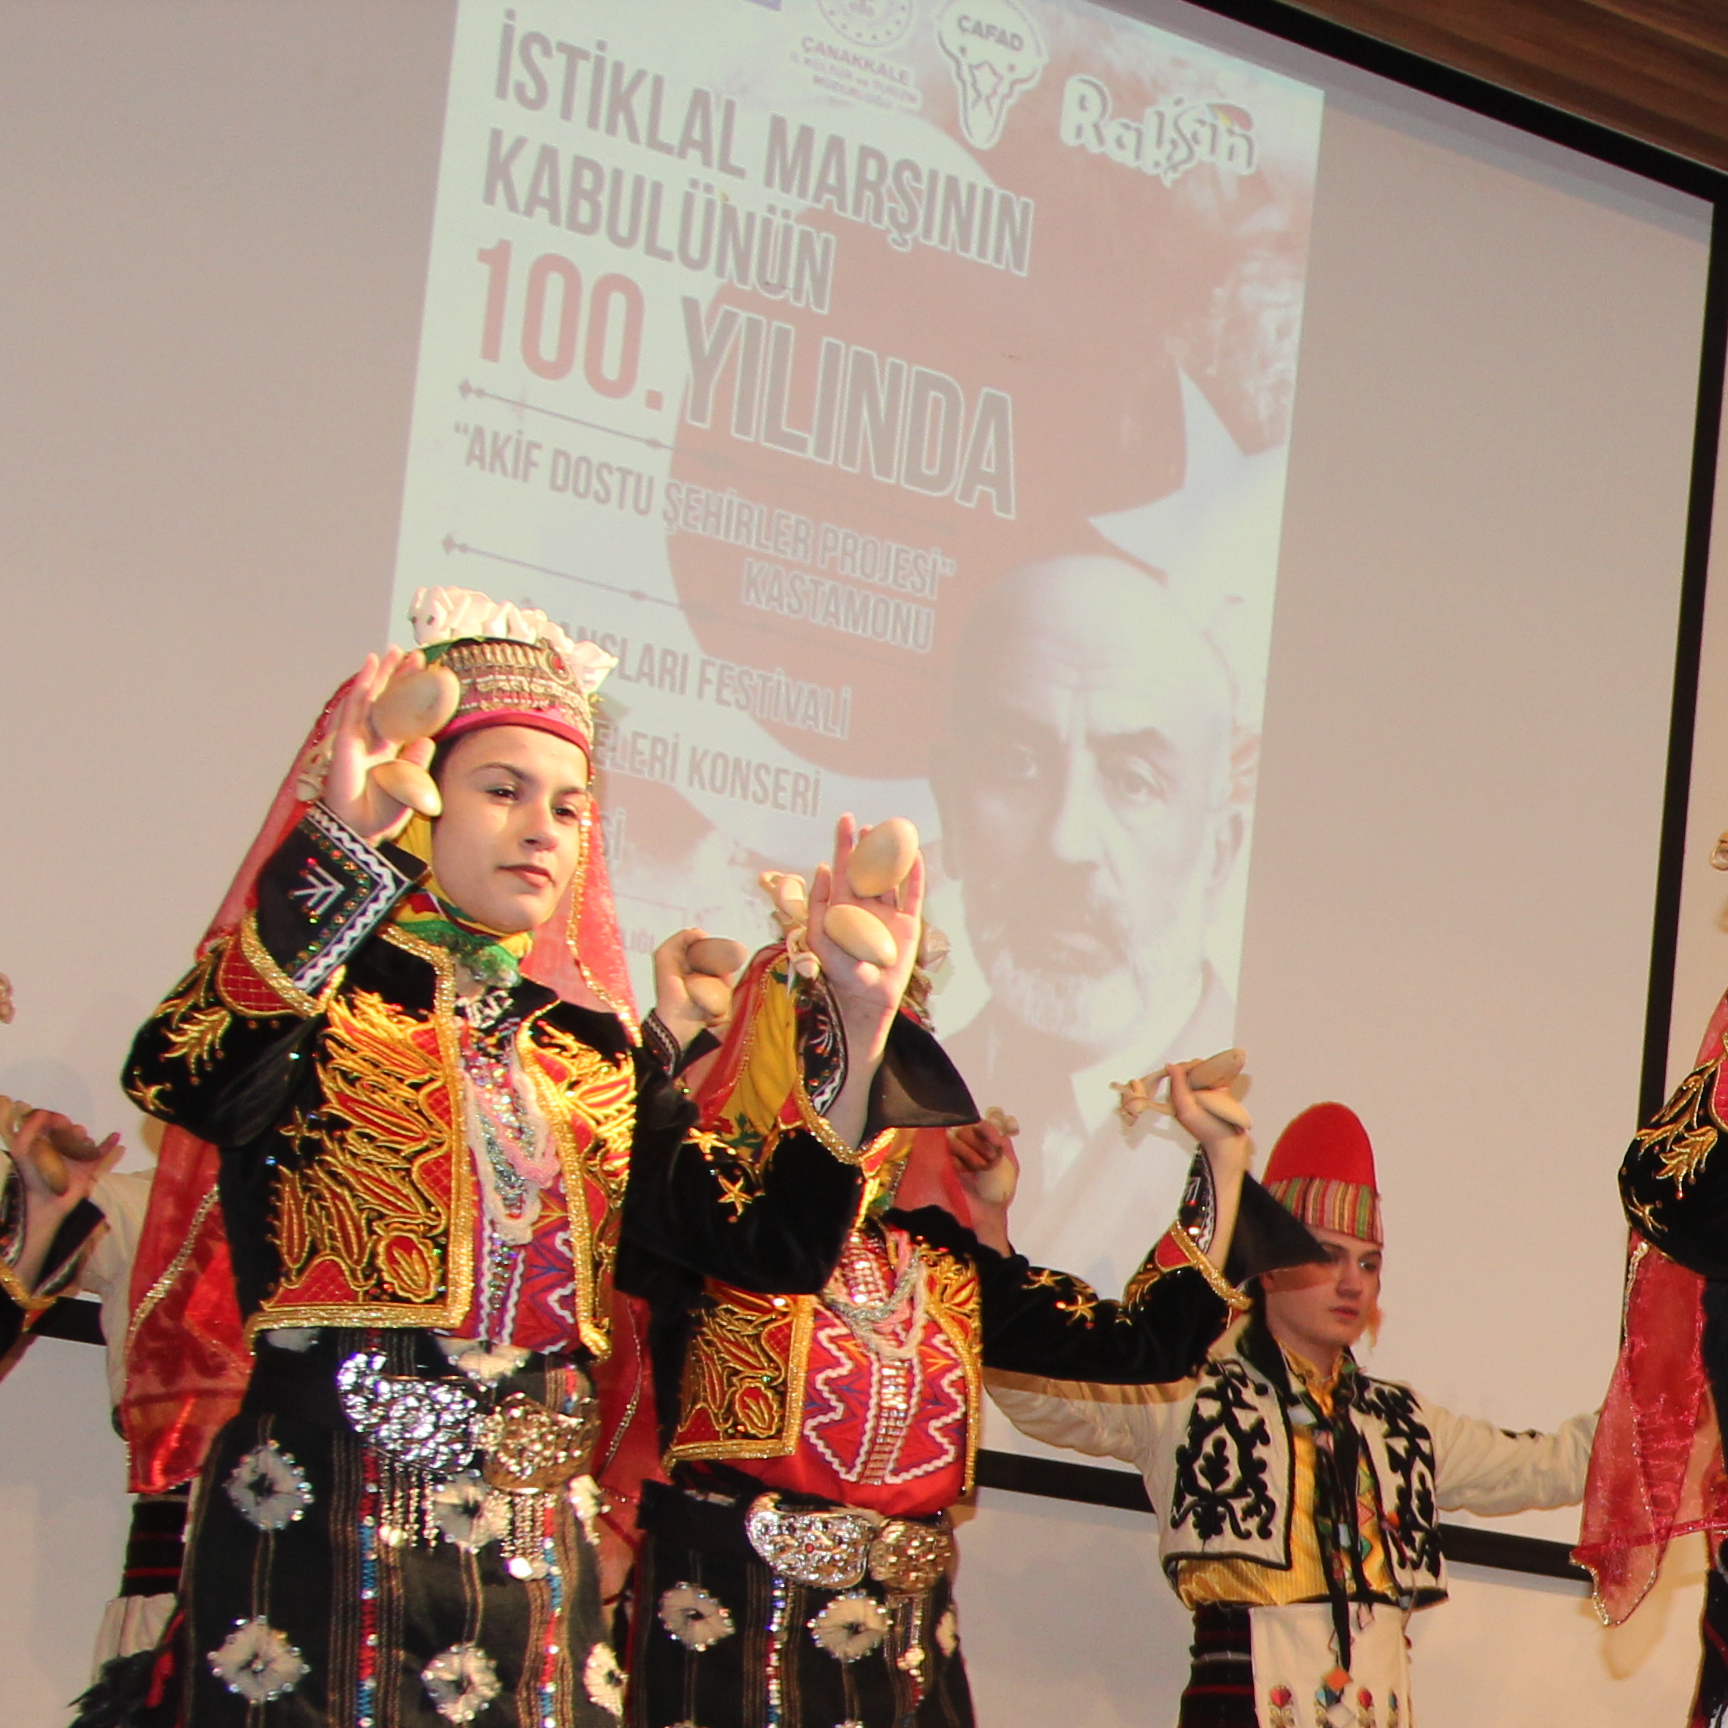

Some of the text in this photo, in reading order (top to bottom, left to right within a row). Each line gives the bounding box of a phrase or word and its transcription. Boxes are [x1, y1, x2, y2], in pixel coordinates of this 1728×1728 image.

[495, 9, 1033, 276] İSTİKLAL MARŞININ
[483, 127, 835, 313] KABULÜNÜN
[477, 239, 1016, 520] 100. YILINDA
[550, 449, 654, 515] DOSTU
[663, 480, 812, 564] ŞEHİRLER
[743, 559, 934, 653] KASTAMONU
[697, 656, 852, 740] FESTİVALİ
[688, 745, 823, 818] KONSERİ
